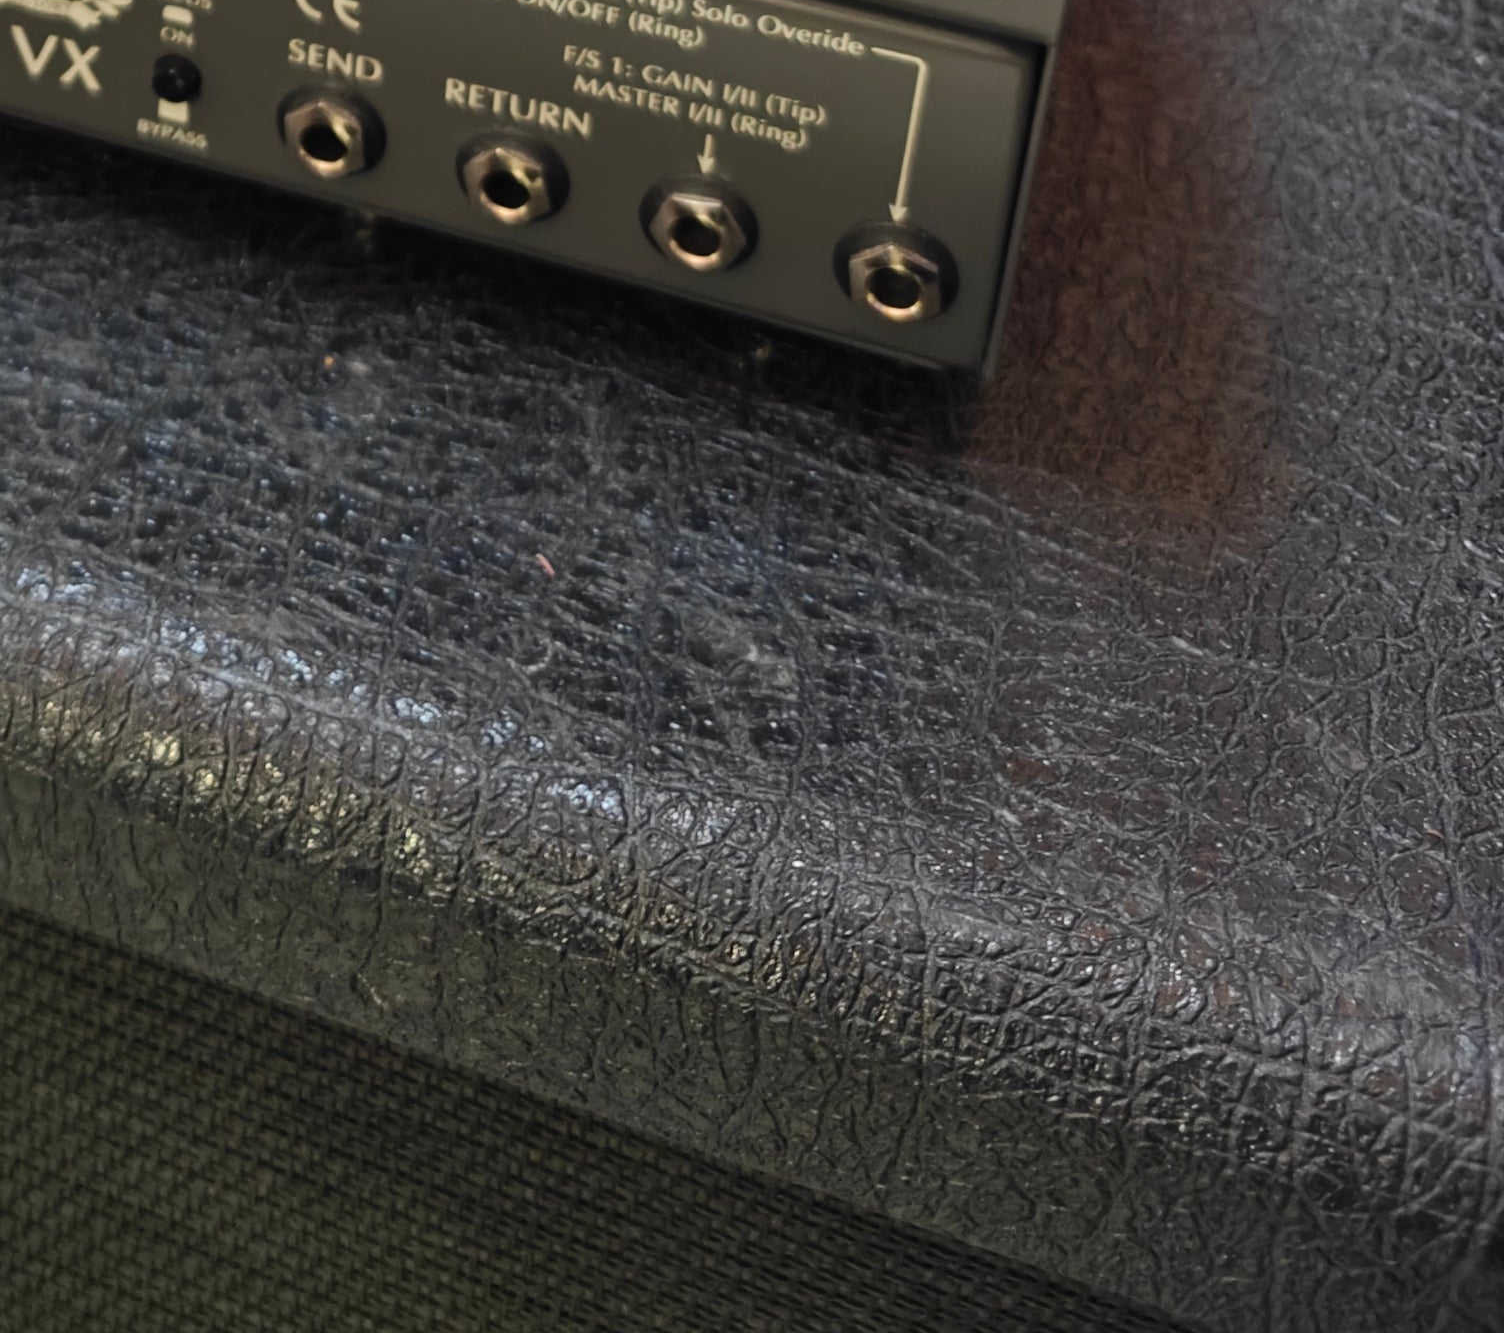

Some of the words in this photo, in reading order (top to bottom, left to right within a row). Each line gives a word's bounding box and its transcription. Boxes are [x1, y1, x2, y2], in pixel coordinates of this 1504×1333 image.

[160, 26, 194, 48] ON
[628, 10, 705, 49] (Ring)
[756, 14, 865, 56] Overide
[11, 25, 101, 93] VX
[288, 38, 383, 81] SEND
[445, 77, 591, 136] RETURN
[563, 44, 601, 70] F/S
[613, 57, 633, 77] 1:
[641, 64, 714, 98] GAIN
[765, 93, 827, 126] (Tip)
[573, 74, 680, 117] MASTER
[730, 112, 808, 150] (Ring)
[137, 118, 208, 150] BYPASS
